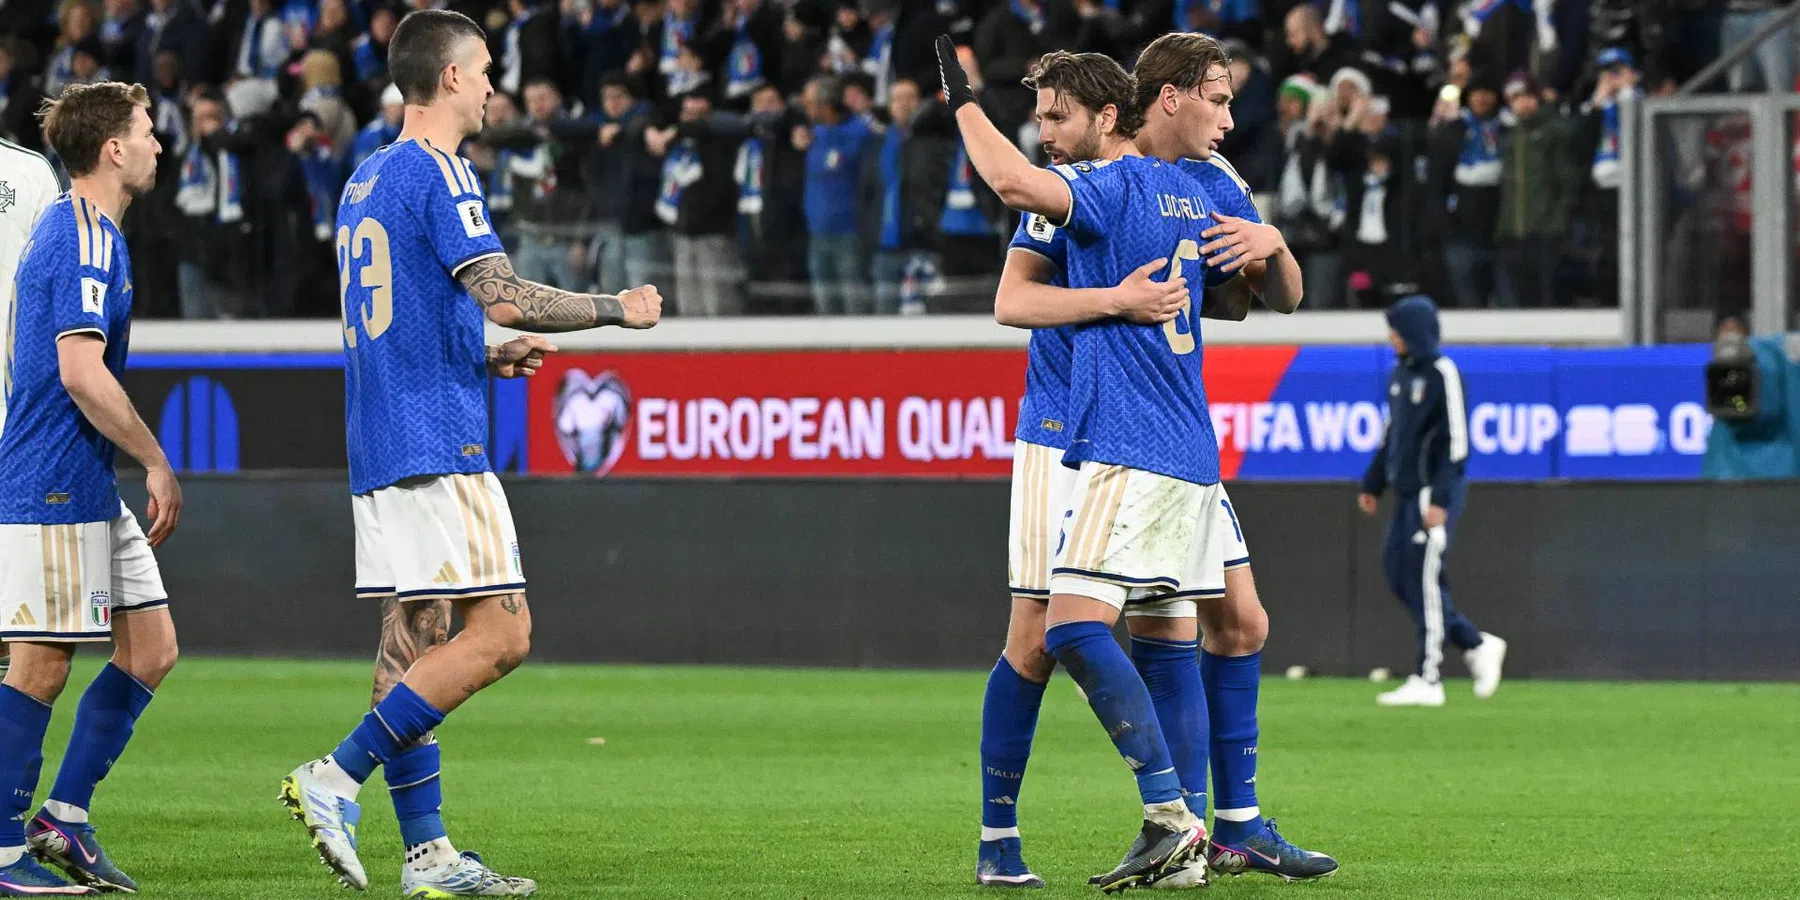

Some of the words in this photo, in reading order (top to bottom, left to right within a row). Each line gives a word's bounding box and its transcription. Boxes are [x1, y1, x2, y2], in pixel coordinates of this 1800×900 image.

[336, 217, 393, 348] 23
[636, 397, 885, 460] EUROPEAN
[897, 396, 1025, 462] QUAL
[1209, 401, 1304, 452] FIFA
[1304, 401, 1393, 452] WO
[1469, 402, 1561, 455] CUP
